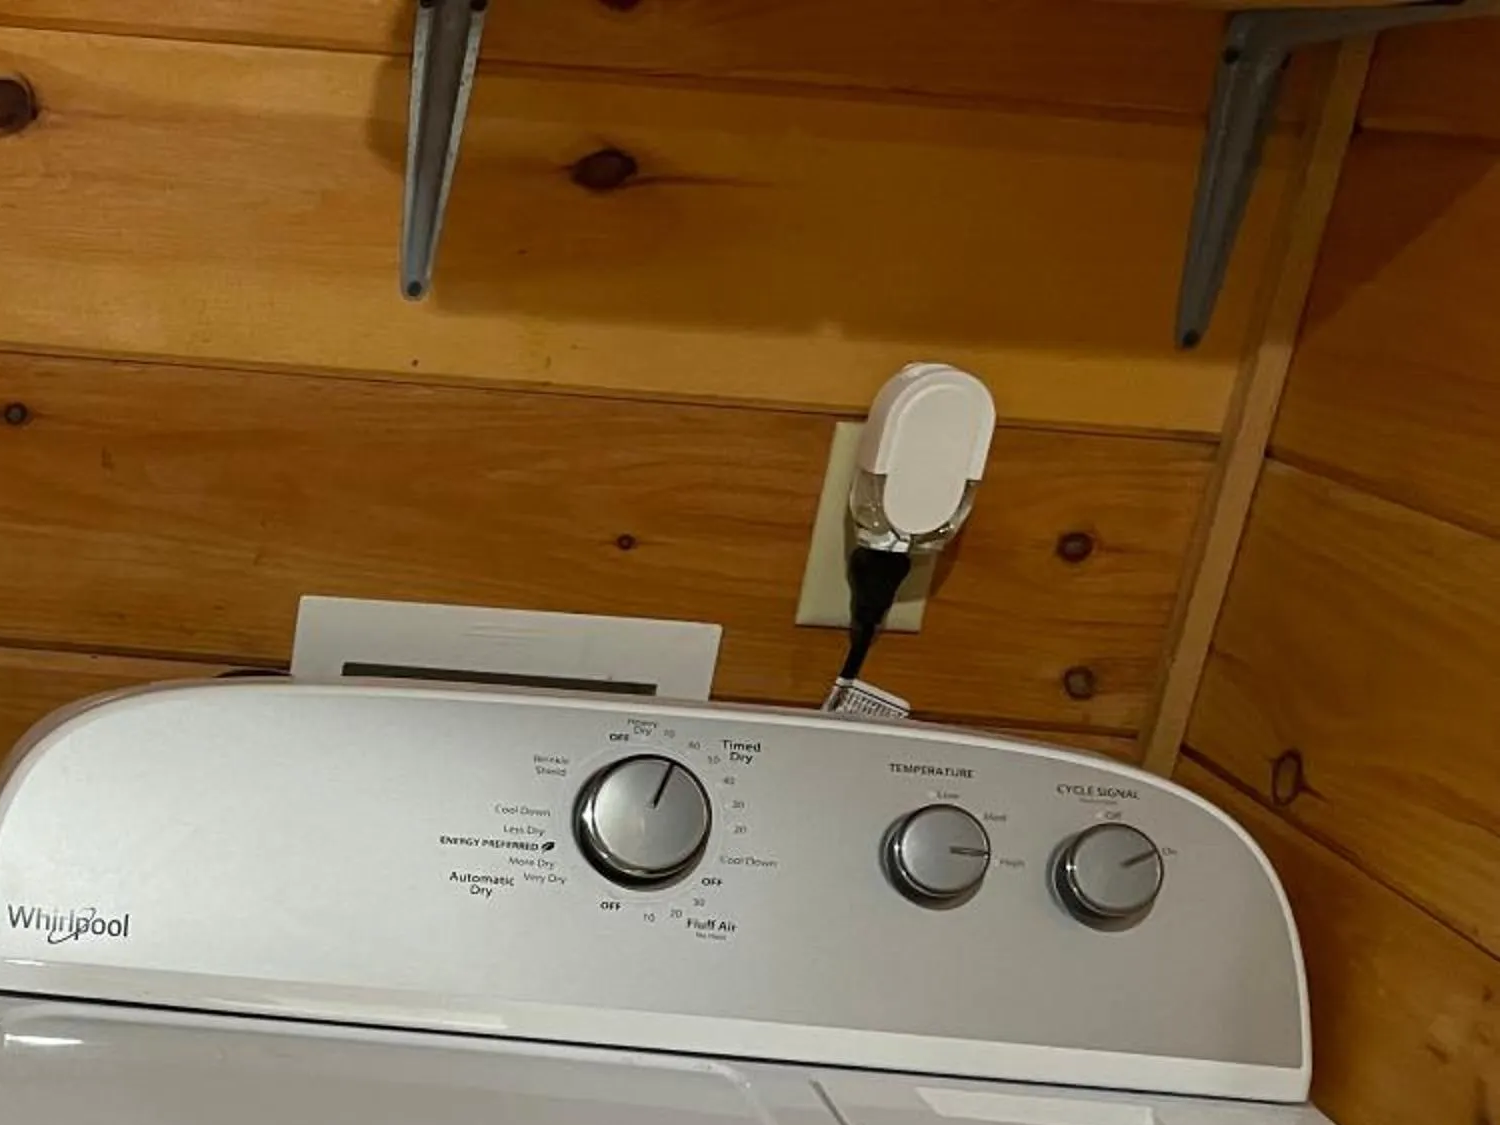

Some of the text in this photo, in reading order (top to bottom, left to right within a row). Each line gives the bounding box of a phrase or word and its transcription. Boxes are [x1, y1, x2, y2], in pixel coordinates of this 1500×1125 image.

[609, 732, 630, 742] OFF
[722, 739, 761, 753] Timed
[729, 751, 754, 765] Dry
[888, 763, 974, 779] TEMPERATURE
[1056, 783, 1141, 800] CYCLE SIGNAL
[494, 803, 519, 816] Cool
[526, 825, 546, 837] Dry
[439, 834, 539, 852] ENERGY PREFERRED
[508, 856, 555, 870] More Dry
[449, 871, 515, 887] Automatic
[523, 872, 568, 886] Very Dry
[701, 877, 723, 888] OFF
[469, 883, 494, 899] Dry
[600, 901, 622, 912] OFF
[7, 903, 130, 945] Whirlpool
[686, 917, 738, 933] Fluff Air
